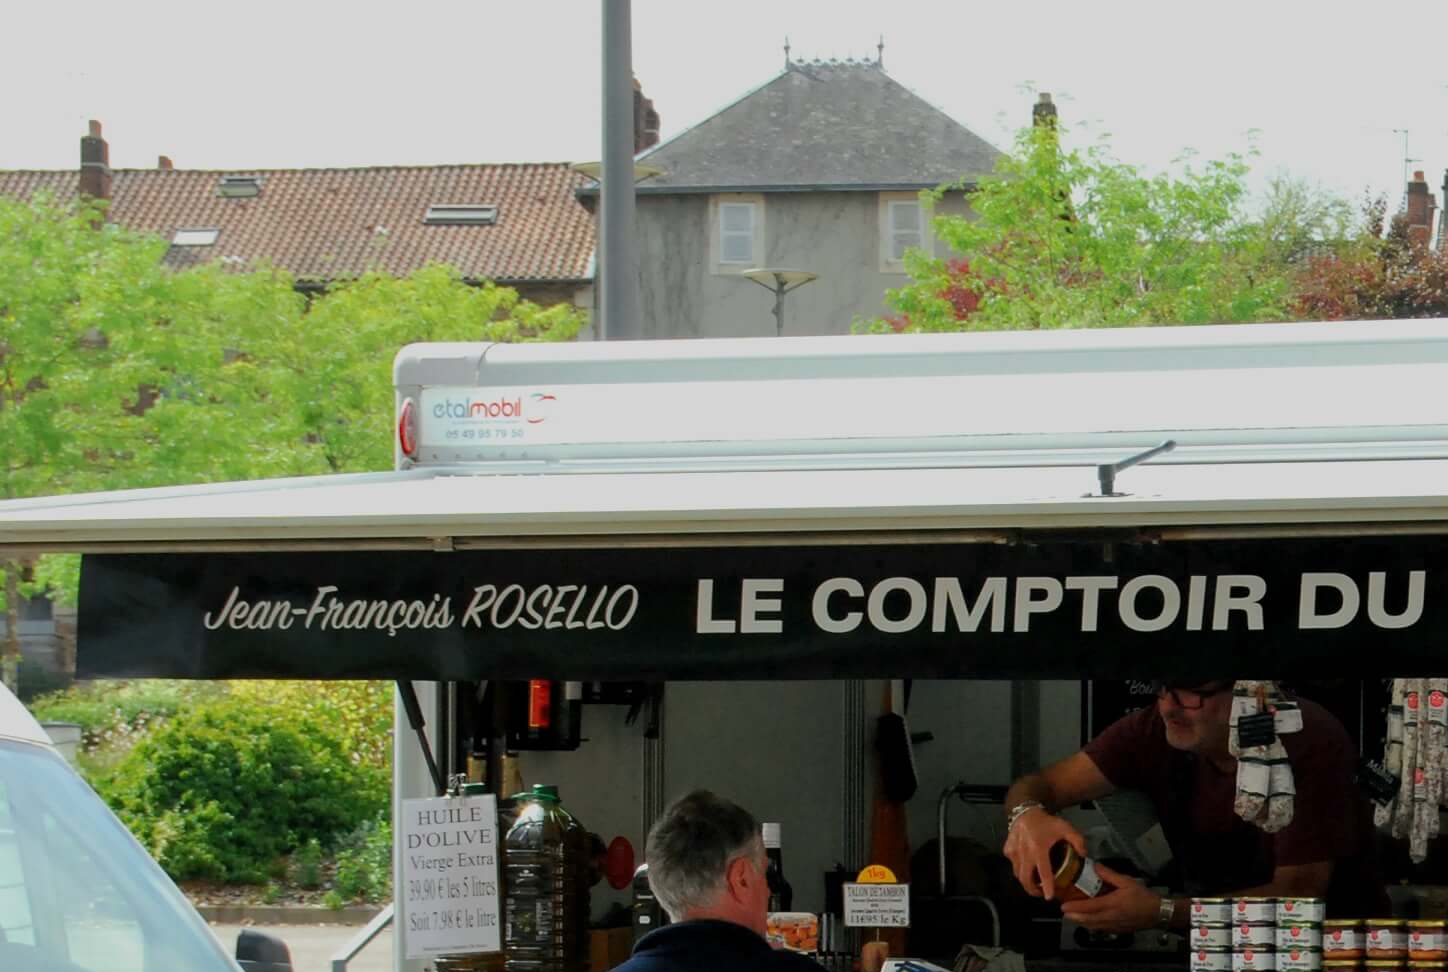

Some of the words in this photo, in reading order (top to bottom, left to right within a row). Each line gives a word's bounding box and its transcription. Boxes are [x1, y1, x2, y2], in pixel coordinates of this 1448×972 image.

[433, 397, 521, 419] etalmobil
[461, 428, 475, 440] 49
[204, 586, 454, 637] Jean-François
[462, 584, 639, 631] ROSELLO
[696, 578, 785, 634] LE
[811, 574, 1267, 633] COMPTOIR
[1298, 570, 1427, 630] DU
[417, 807, 482, 827] HUILE
[407, 828, 492, 850] D'OLIVE
[410, 854, 454, 873] Vierge
[457, 851, 494, 868] Extra
[447, 875, 461, 899] les
[471, 874, 496, 897] litres
[410, 910, 431, 932] Soit
[465, 906, 474, 928] le
[475, 905, 496, 928] litre
